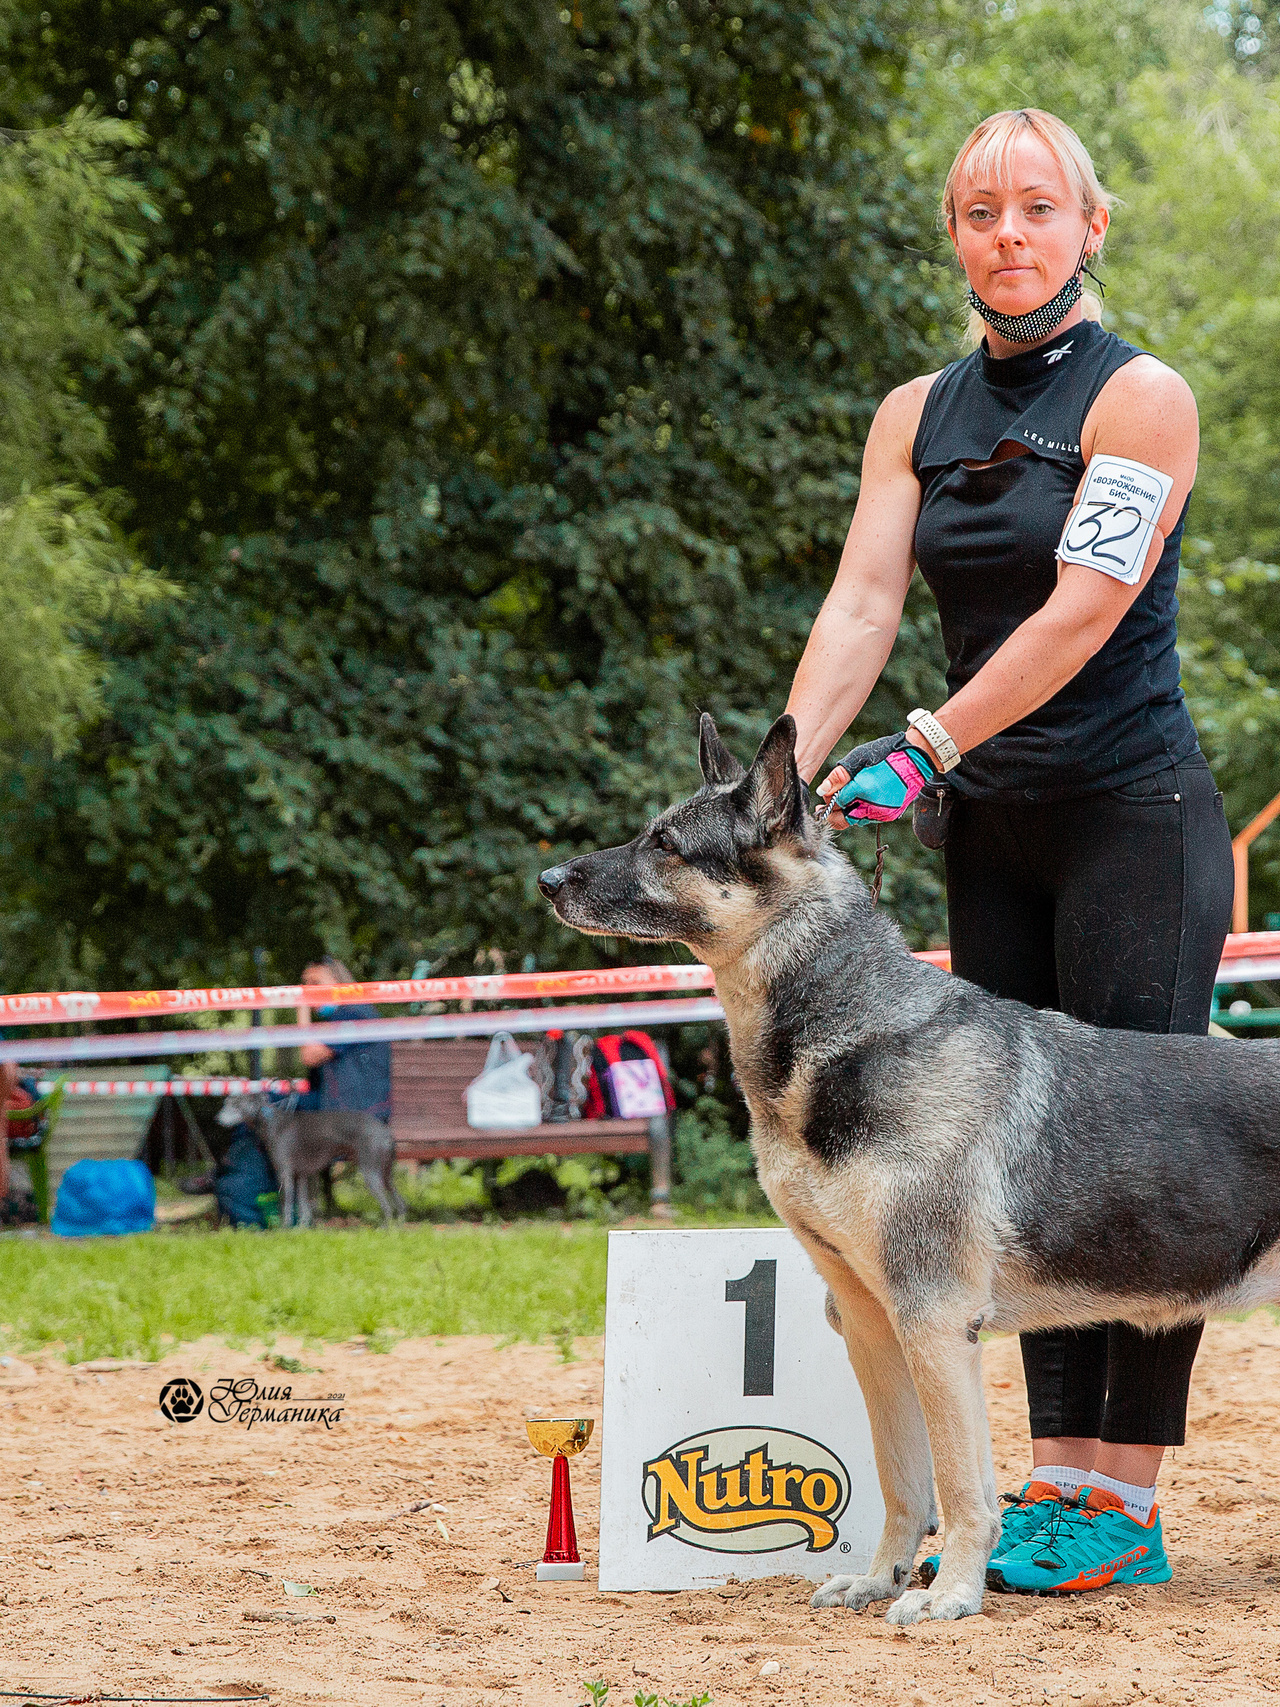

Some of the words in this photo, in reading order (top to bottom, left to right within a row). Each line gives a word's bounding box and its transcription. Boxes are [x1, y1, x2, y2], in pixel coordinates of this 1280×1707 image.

[1023, 429, 1044, 445] LES
[1046, 440, 1080, 454] MILLS
[1093, 476, 1157, 504] «ВОЗРОЖДЕНИЕ
[1108, 488, 1131, 502] БИС»
[1065, 500, 1142, 567] 32
[725, 1258, 778, 1397] 1
[644, 1444, 843, 1550] Nutro
[1054, 1480, 1079, 1490] SPO
[1083, 1549, 1142, 1581] salomon
